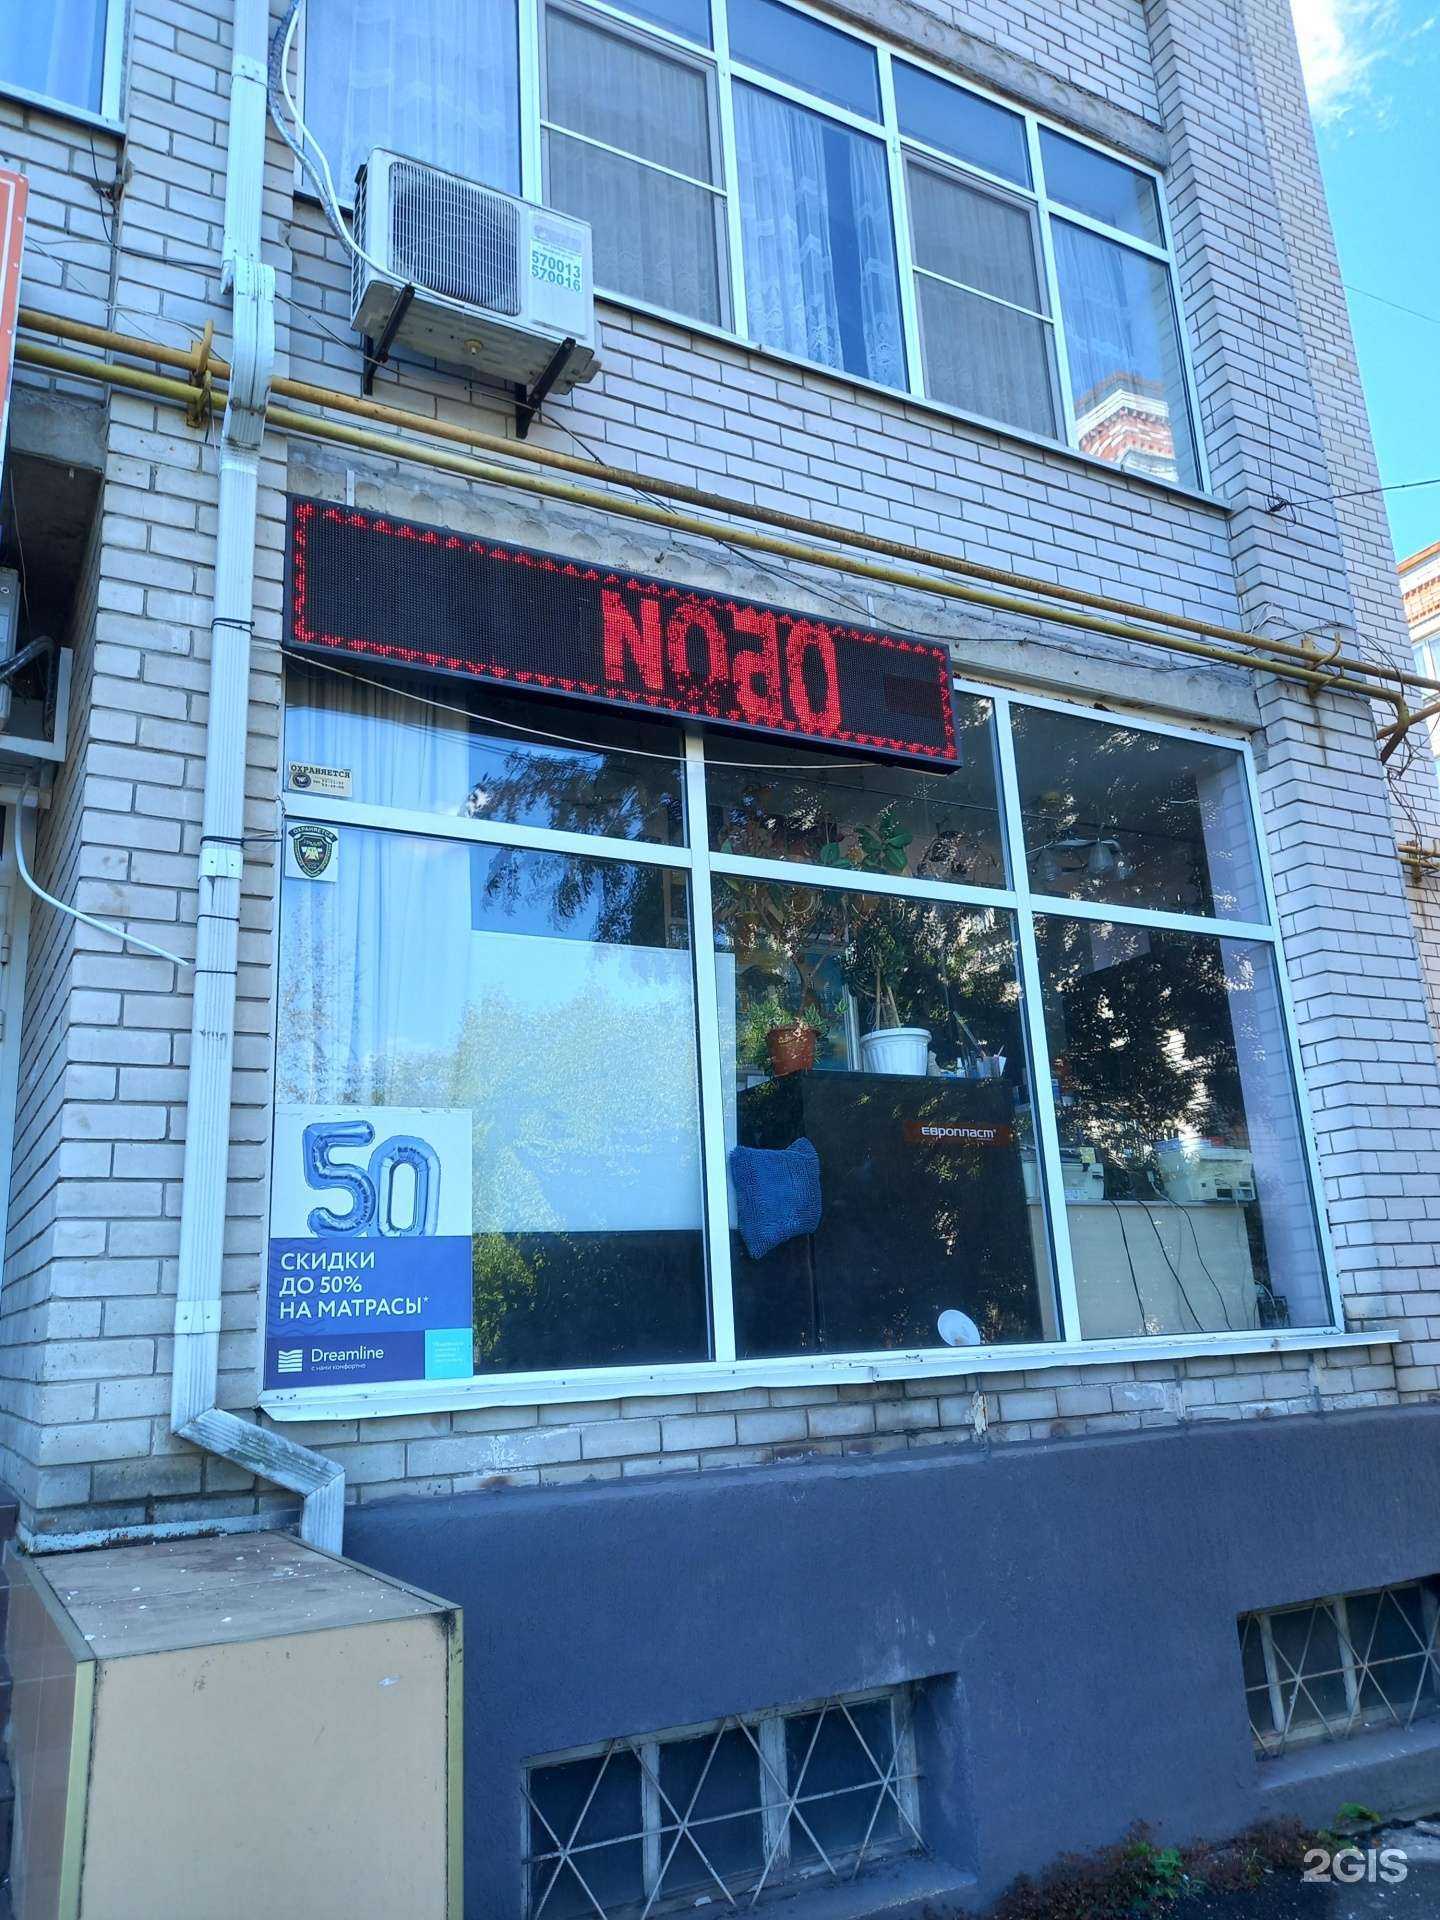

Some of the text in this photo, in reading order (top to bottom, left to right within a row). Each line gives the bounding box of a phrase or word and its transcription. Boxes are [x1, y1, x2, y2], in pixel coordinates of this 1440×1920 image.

[531, 250, 581, 279] 570013
[531, 264, 581, 292] 570016
[290, 764, 351, 778] ОХРАНЯЕТСЯ
[292, 826, 334, 839] ОХРАНЯЕТСЯ
[302, 1120, 442, 1238] 50
[280, 1251, 376, 1272] СКИДКИ
[278, 1276, 362, 1297] ДО 50%
[279, 1303, 312, 1320] НА
[311, 1346, 384, 1363] Dreamline
